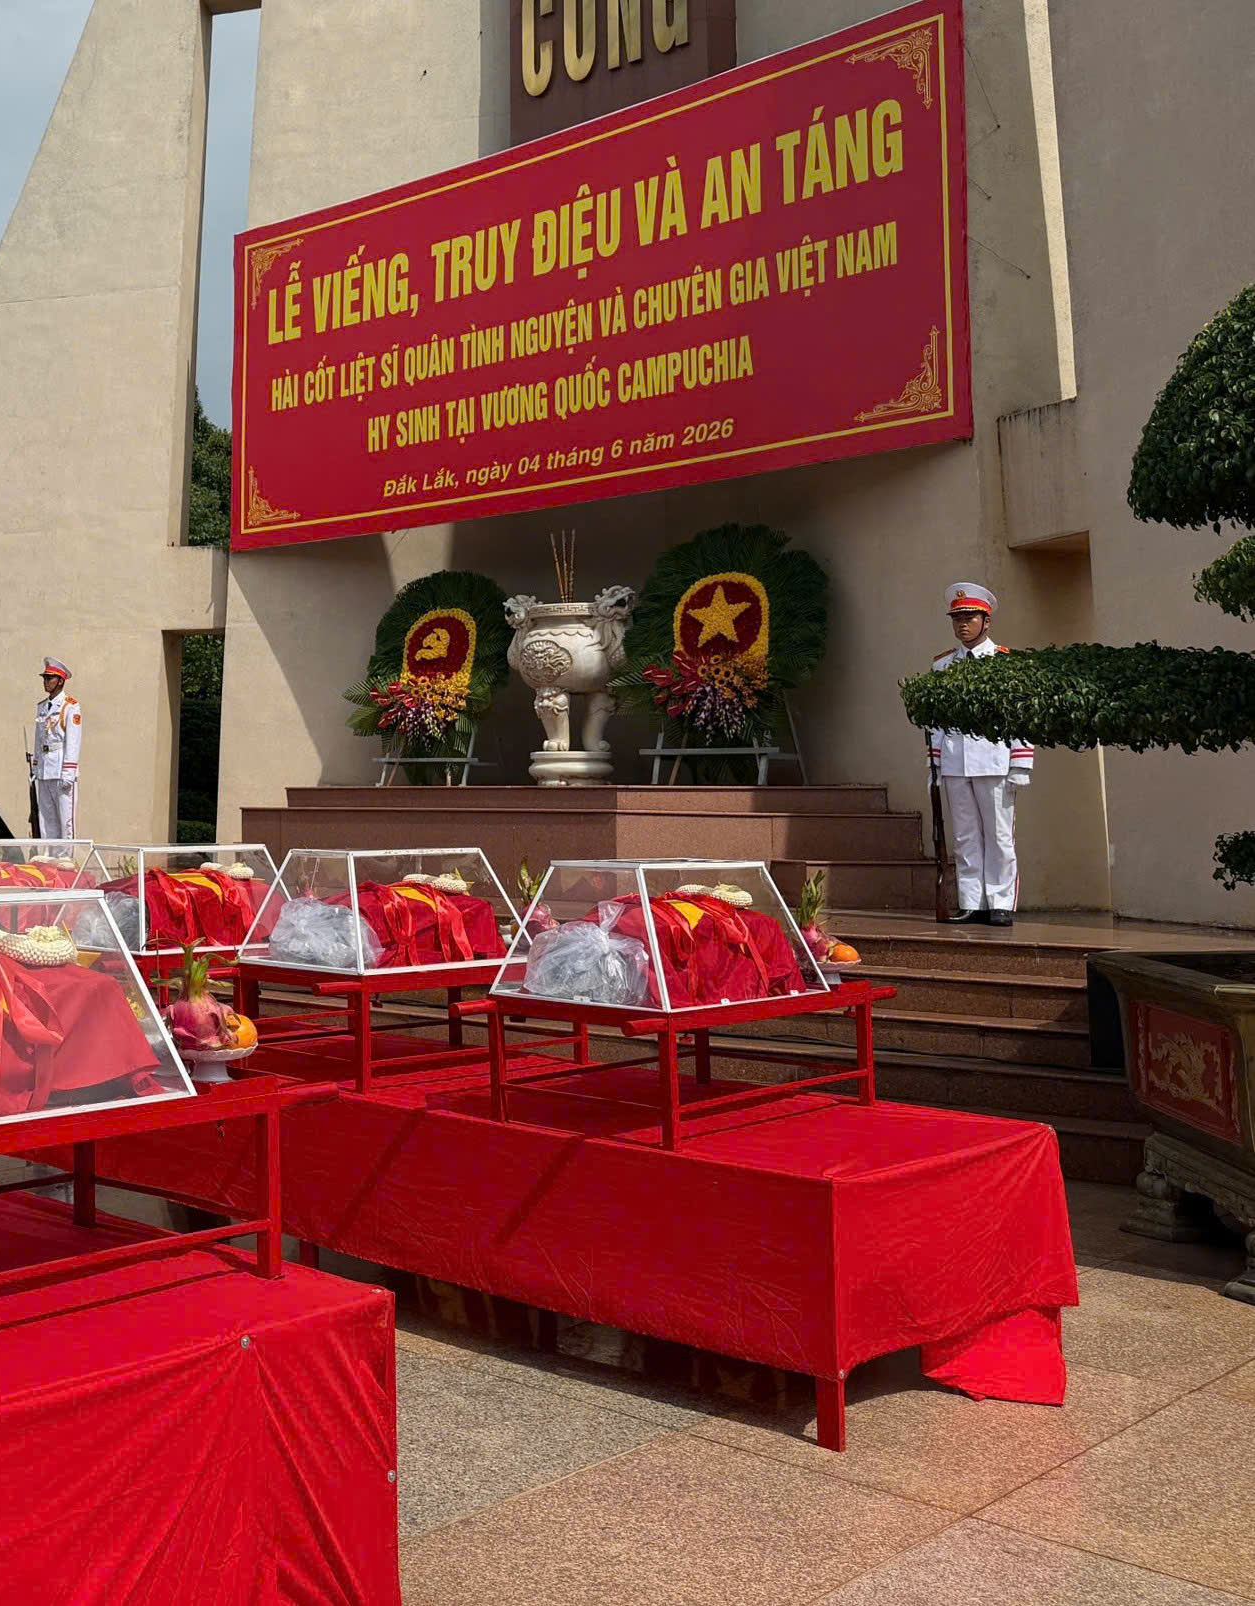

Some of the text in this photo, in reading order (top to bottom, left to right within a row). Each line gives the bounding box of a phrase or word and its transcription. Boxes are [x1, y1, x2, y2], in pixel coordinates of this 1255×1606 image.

[268, 100, 902, 345] LỄ VIẾNG, TRUY ĐIỆU VÀ AN TÁNG
[272, 221, 897, 411] HÀI CỐT LIỆT SĨ QUÂN TÌNH NGUYỆN VÀ CHUYÊN GIA VIỆT NAM
[368, 336, 753, 452] HY SINH TẠI VƯƠNG QUỐC CAMPUCHIA
[384, 419, 733, 496] Đắk Lắk, ngày 04 tháng 6 năm 2026
